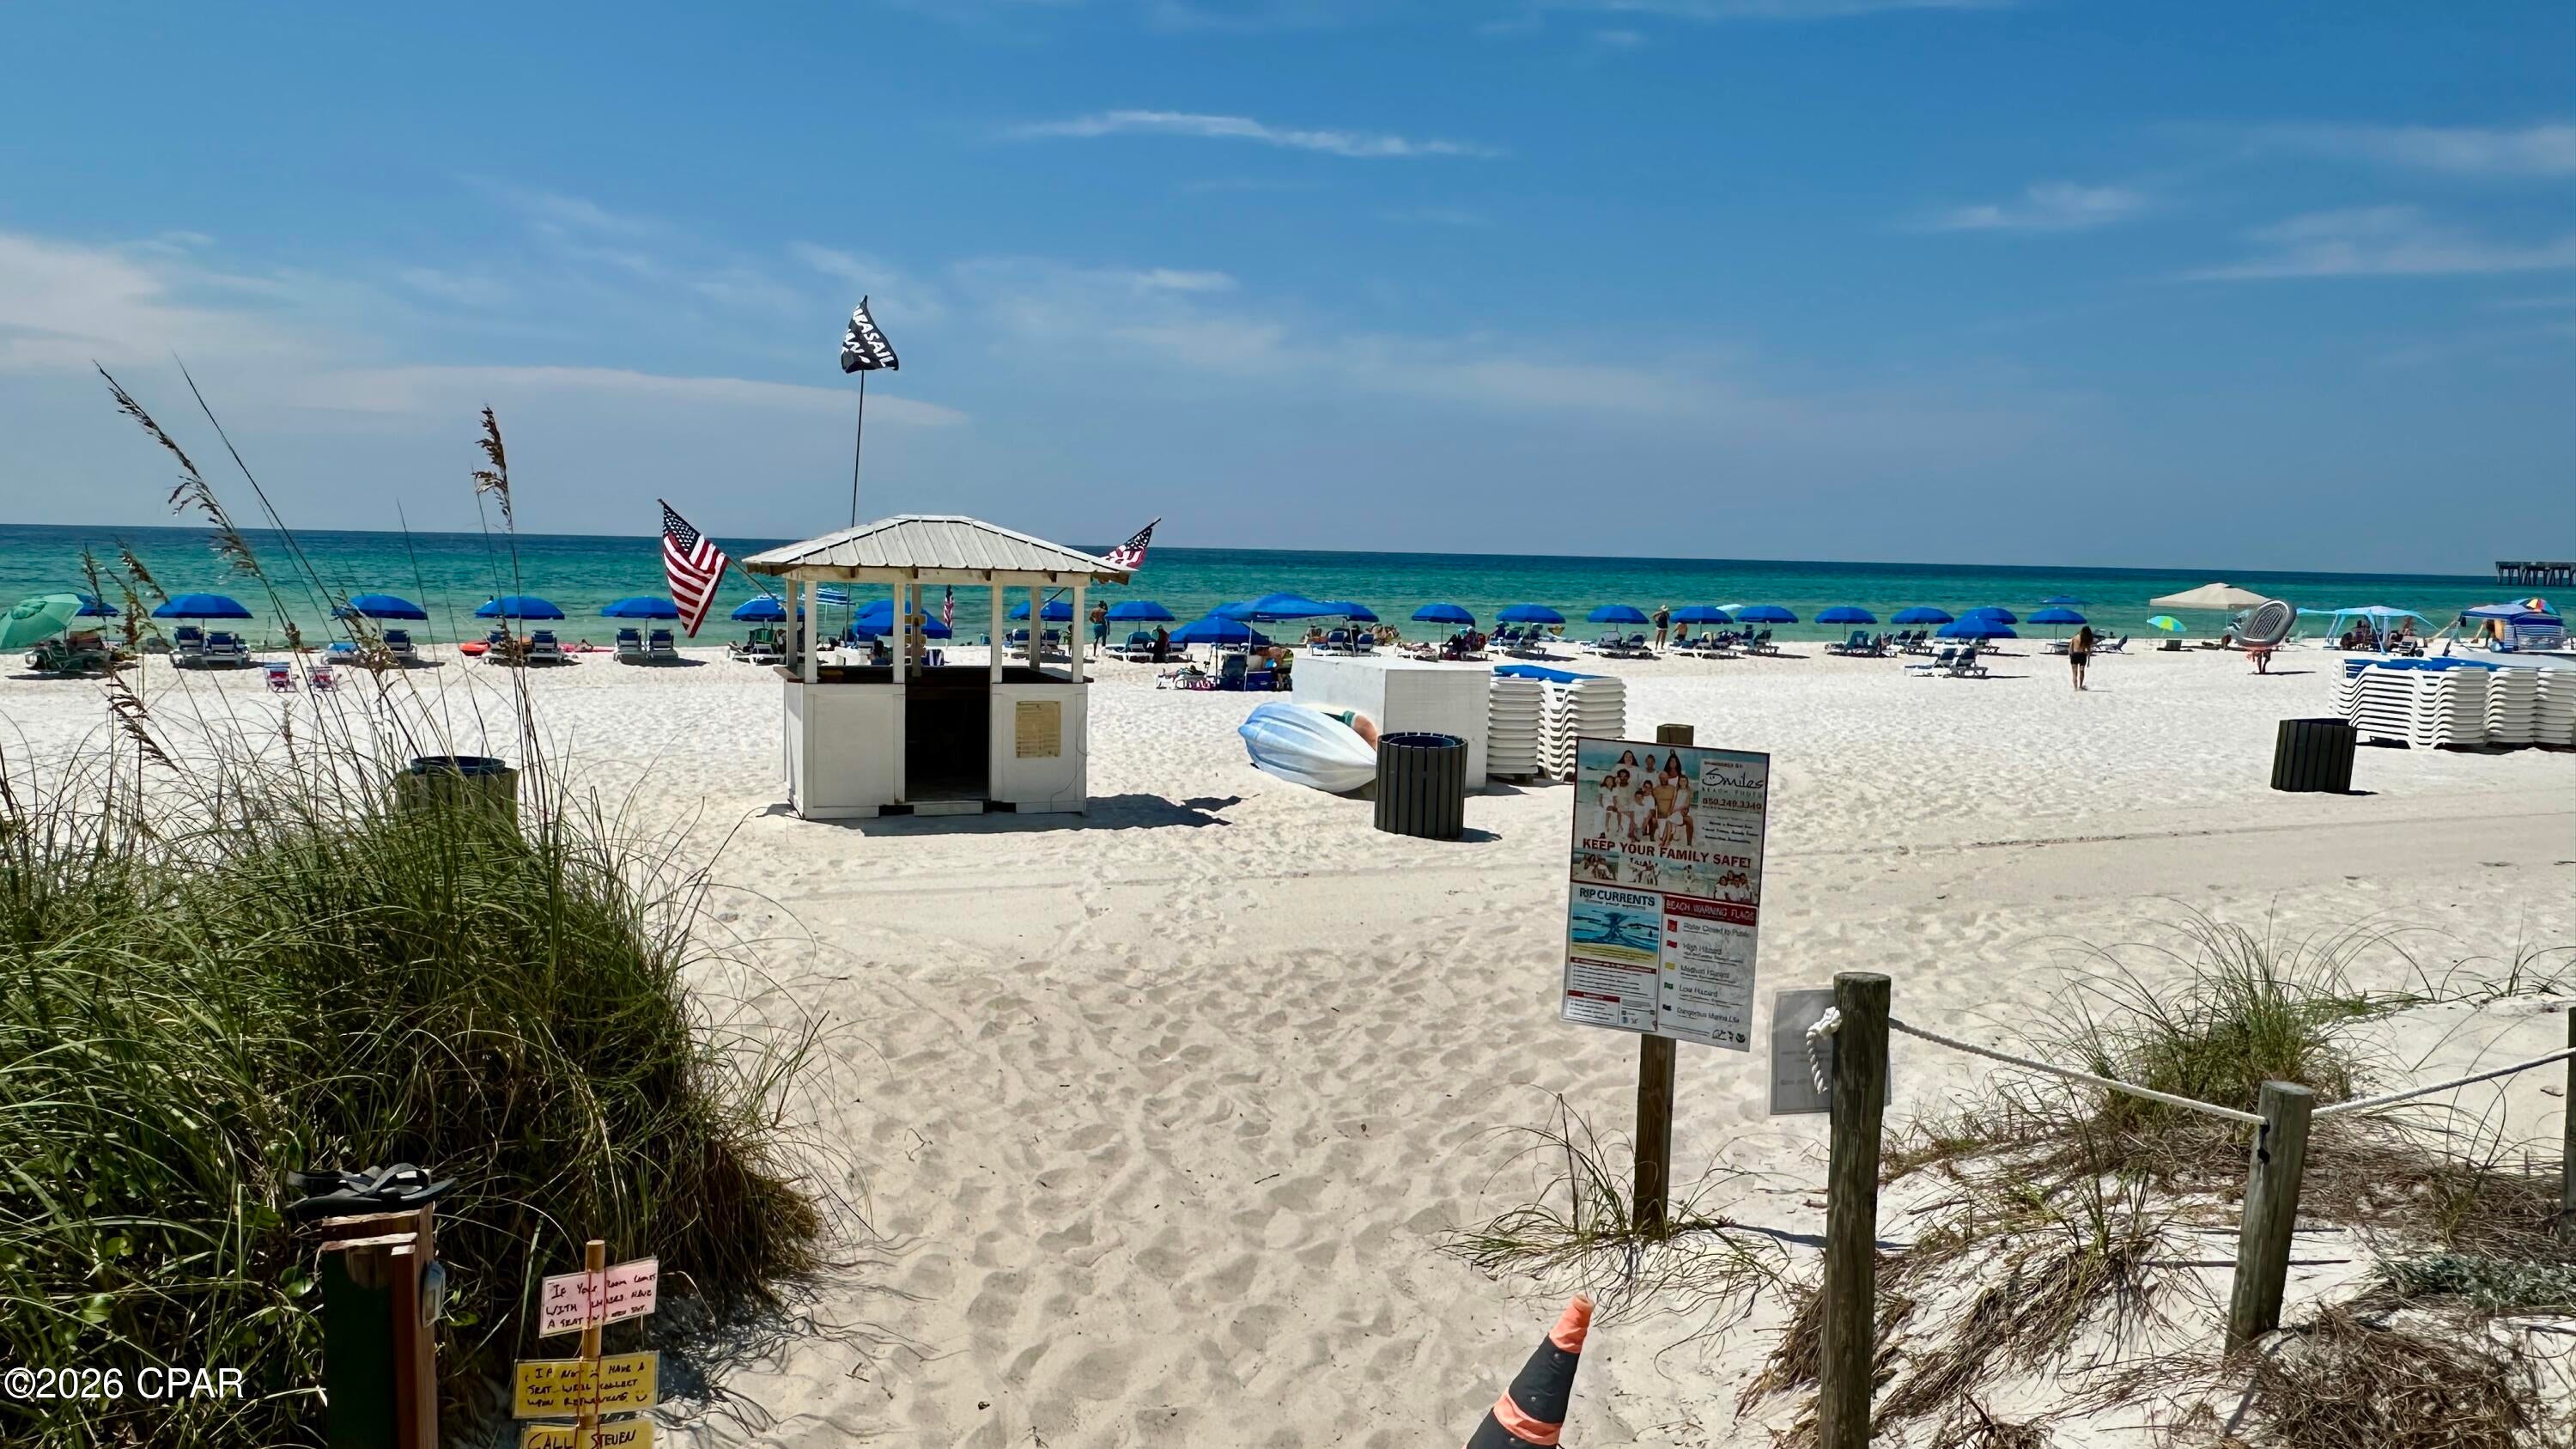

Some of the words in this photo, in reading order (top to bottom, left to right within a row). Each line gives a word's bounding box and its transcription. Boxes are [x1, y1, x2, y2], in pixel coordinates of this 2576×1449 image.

[1702, 768, 1764, 788] Smiles
[1583, 837, 1615, 852] KEEP
[1619, 842, 1655, 857] YOUR
[1659, 847, 1710, 864] FAMILY
[1713, 853, 1751, 868] SAFE!
[1580, 887, 1596, 898] RIP
[1597, 890, 1656, 906] CURRENTS
[1666, 899, 1691, 910] BEACH
[1692, 904, 1728, 916] WARNING
[1730, 909, 1754, 921] FLAGS
[1679, 983, 1692, 993] Low
[546, 1303, 577, 1316] WITH
[547, 1318, 556, 1329] A
[608, 1364, 632, 1375] HAVE
[527, 1431, 573, 1449] CALL
